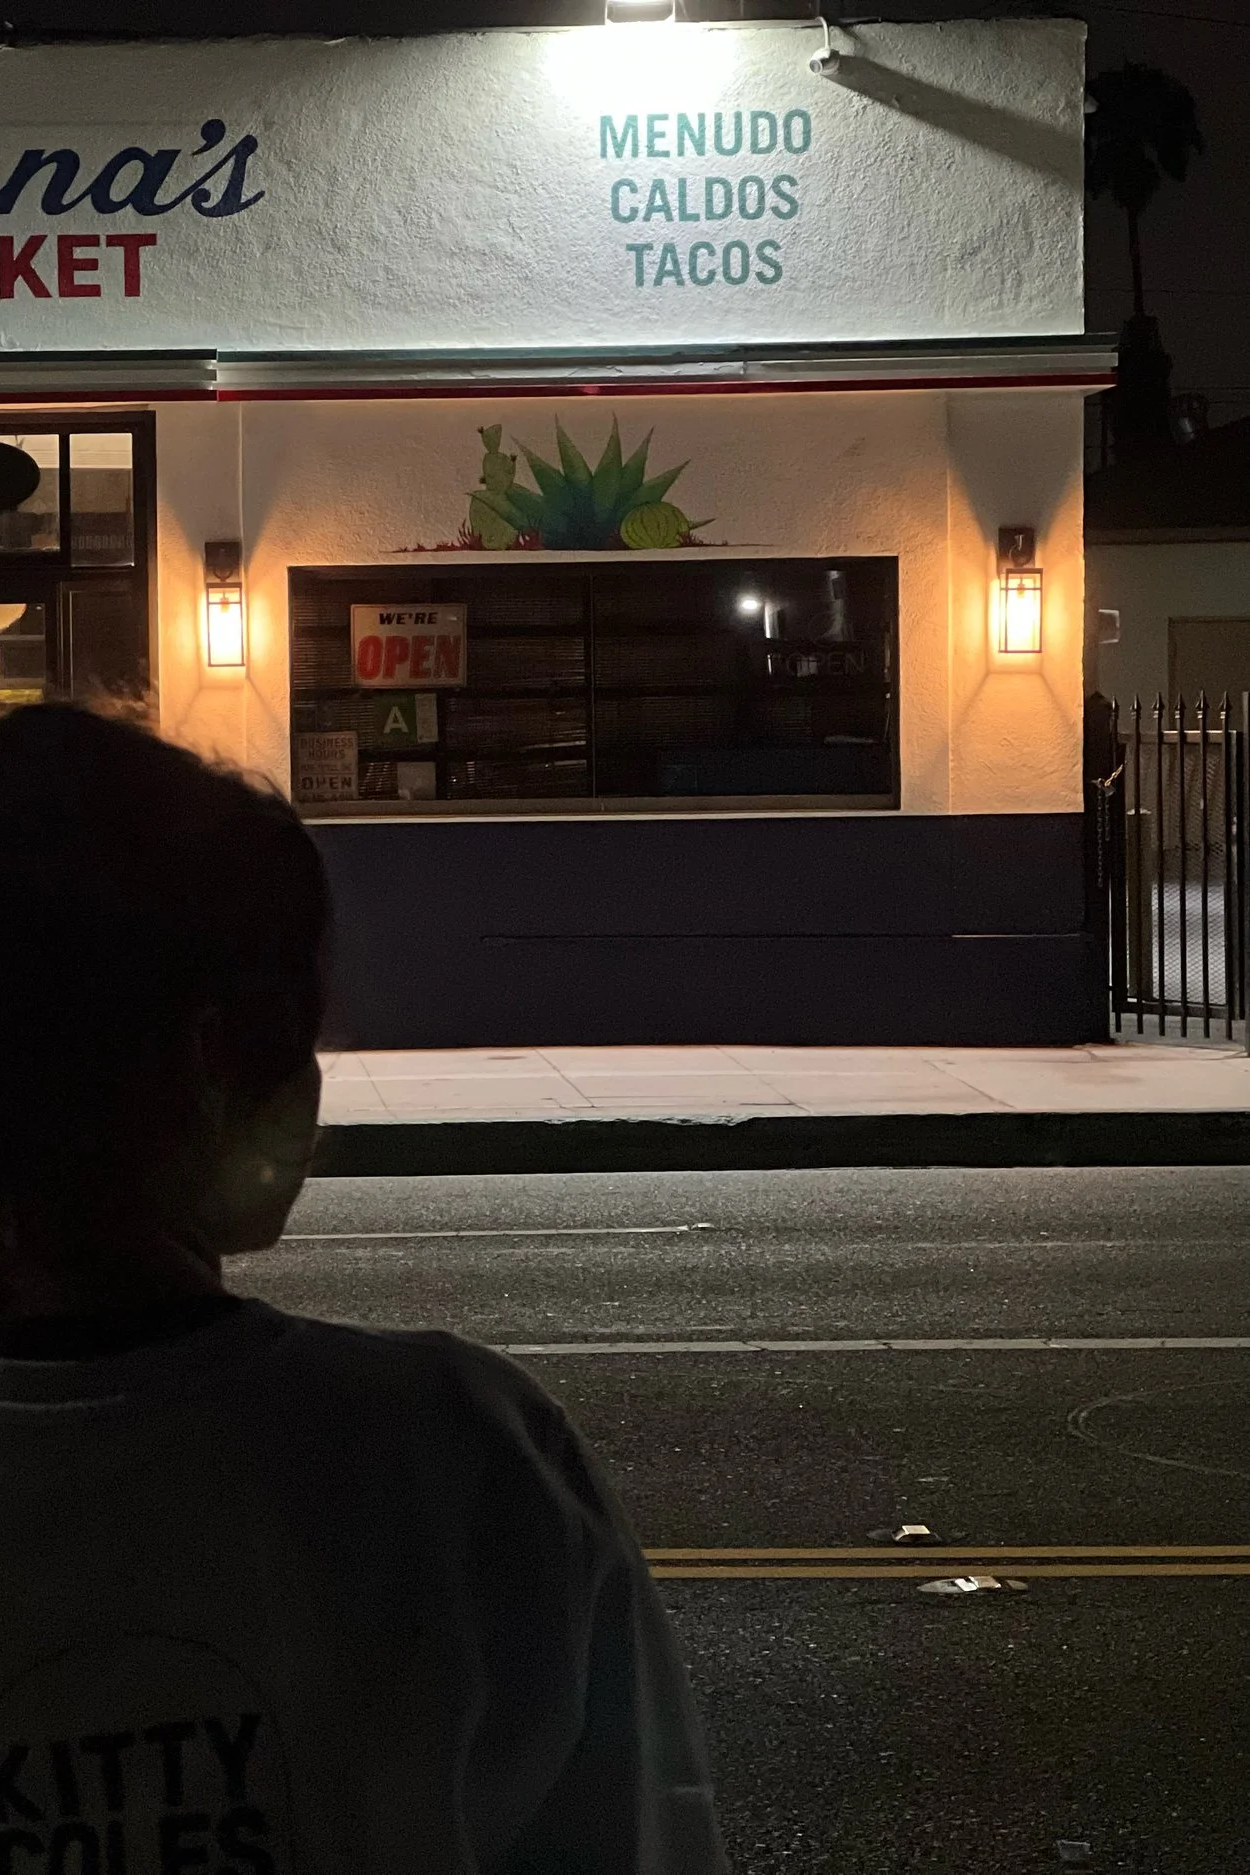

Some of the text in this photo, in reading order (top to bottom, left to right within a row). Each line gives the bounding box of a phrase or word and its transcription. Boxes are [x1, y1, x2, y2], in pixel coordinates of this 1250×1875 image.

[599, 108, 812, 159] MENUDO
[610, 174, 799, 224] CALDOS
[625, 239, 784, 288] TACOS
[379, 612, 438, 625] WE'RE
[357, 635, 462, 680] OPEN
[786, 651, 866, 676] OPEN
[383, 705, 409, 734] A
[300, 737, 354, 749] BUSINESS
[308, 749, 346, 760] HOURS
[301, 776, 353, 790] OPEN
